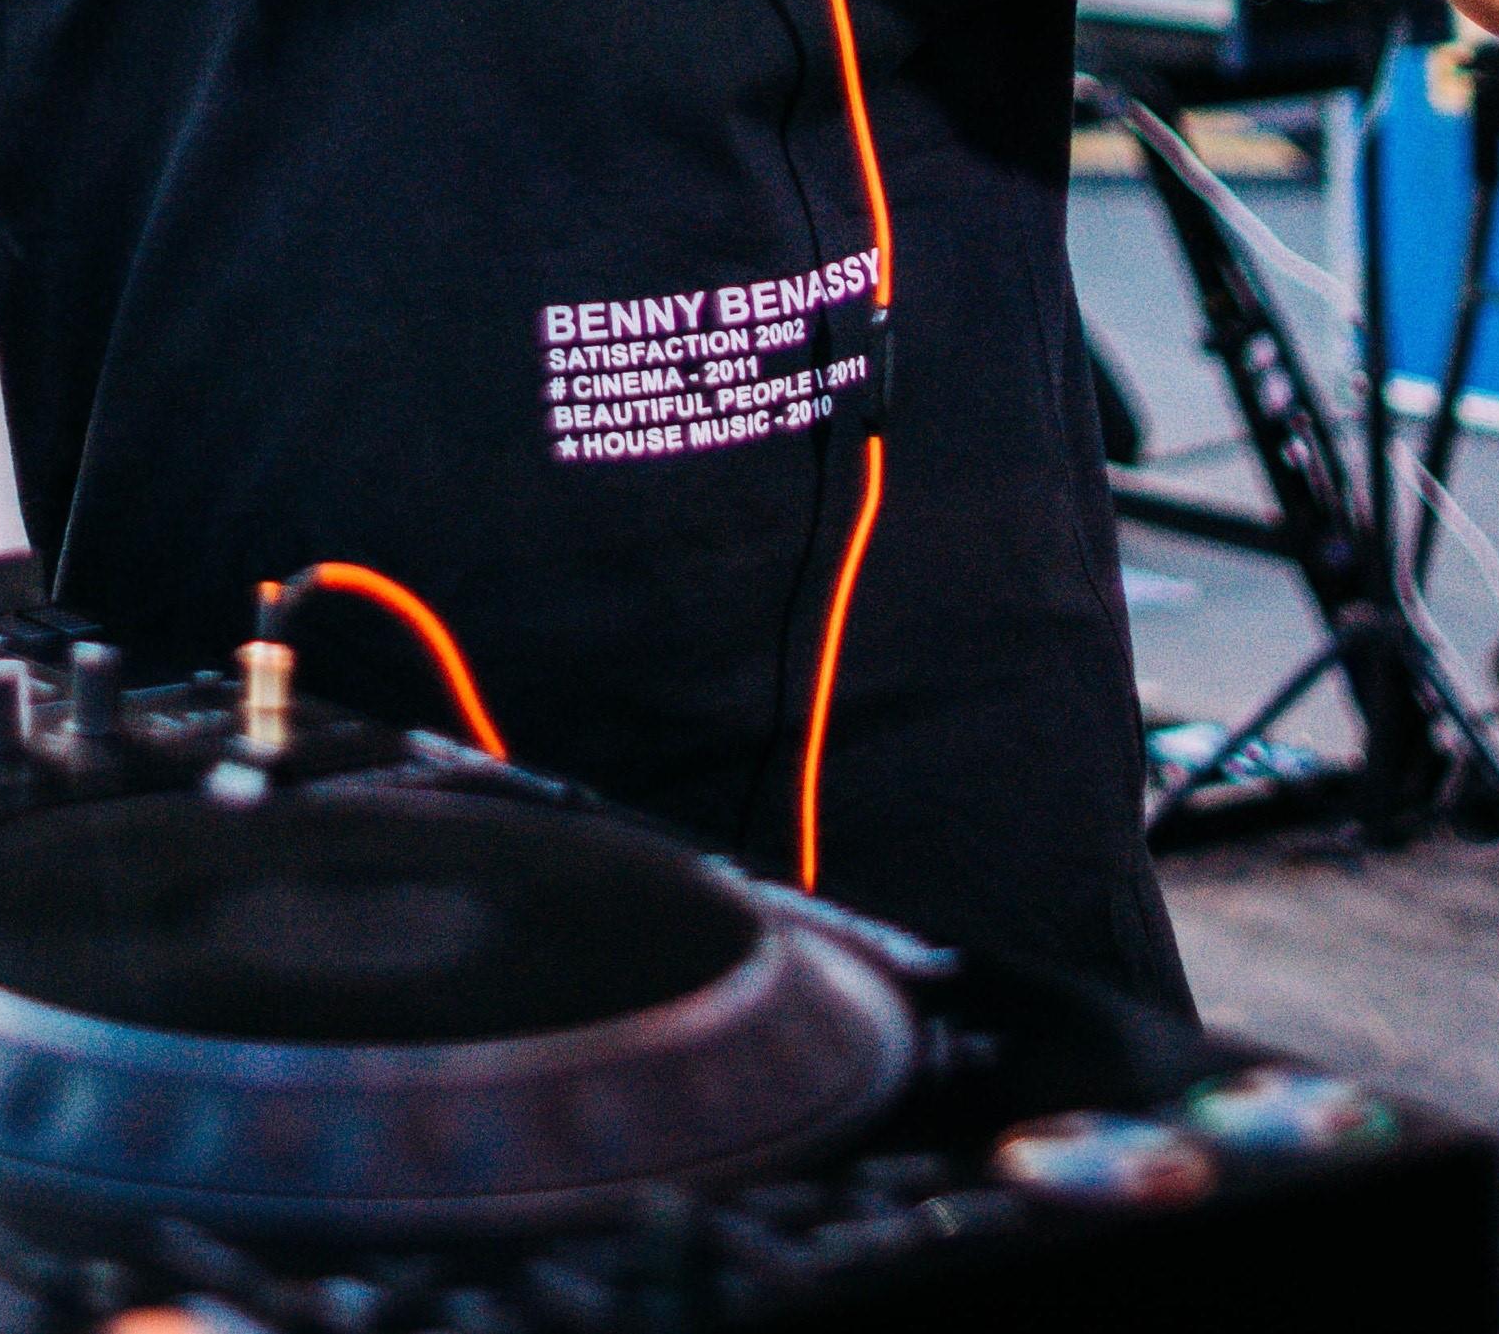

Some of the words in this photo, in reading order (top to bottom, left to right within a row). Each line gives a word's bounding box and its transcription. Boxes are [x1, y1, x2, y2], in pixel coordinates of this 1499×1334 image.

[547, 291, 704, 342] BENNY
[718, 248, 879, 324] BENASSY
[549, 328, 749, 371] SATISFACTION
[756, 318, 805, 348] 2002
[572, 367, 684, 398] CINEMA
[704, 355, 758, 384] 2011
[554, 393, 712, 429] BEAUTIFUL
[718, 371, 813, 412] PEOPLE
[827, 355, 866, 386] 2011
[583, 425, 684, 458] HOUSE
[690, 410, 770, 447] MUSIC
[787, 394, 832, 427] 2010
